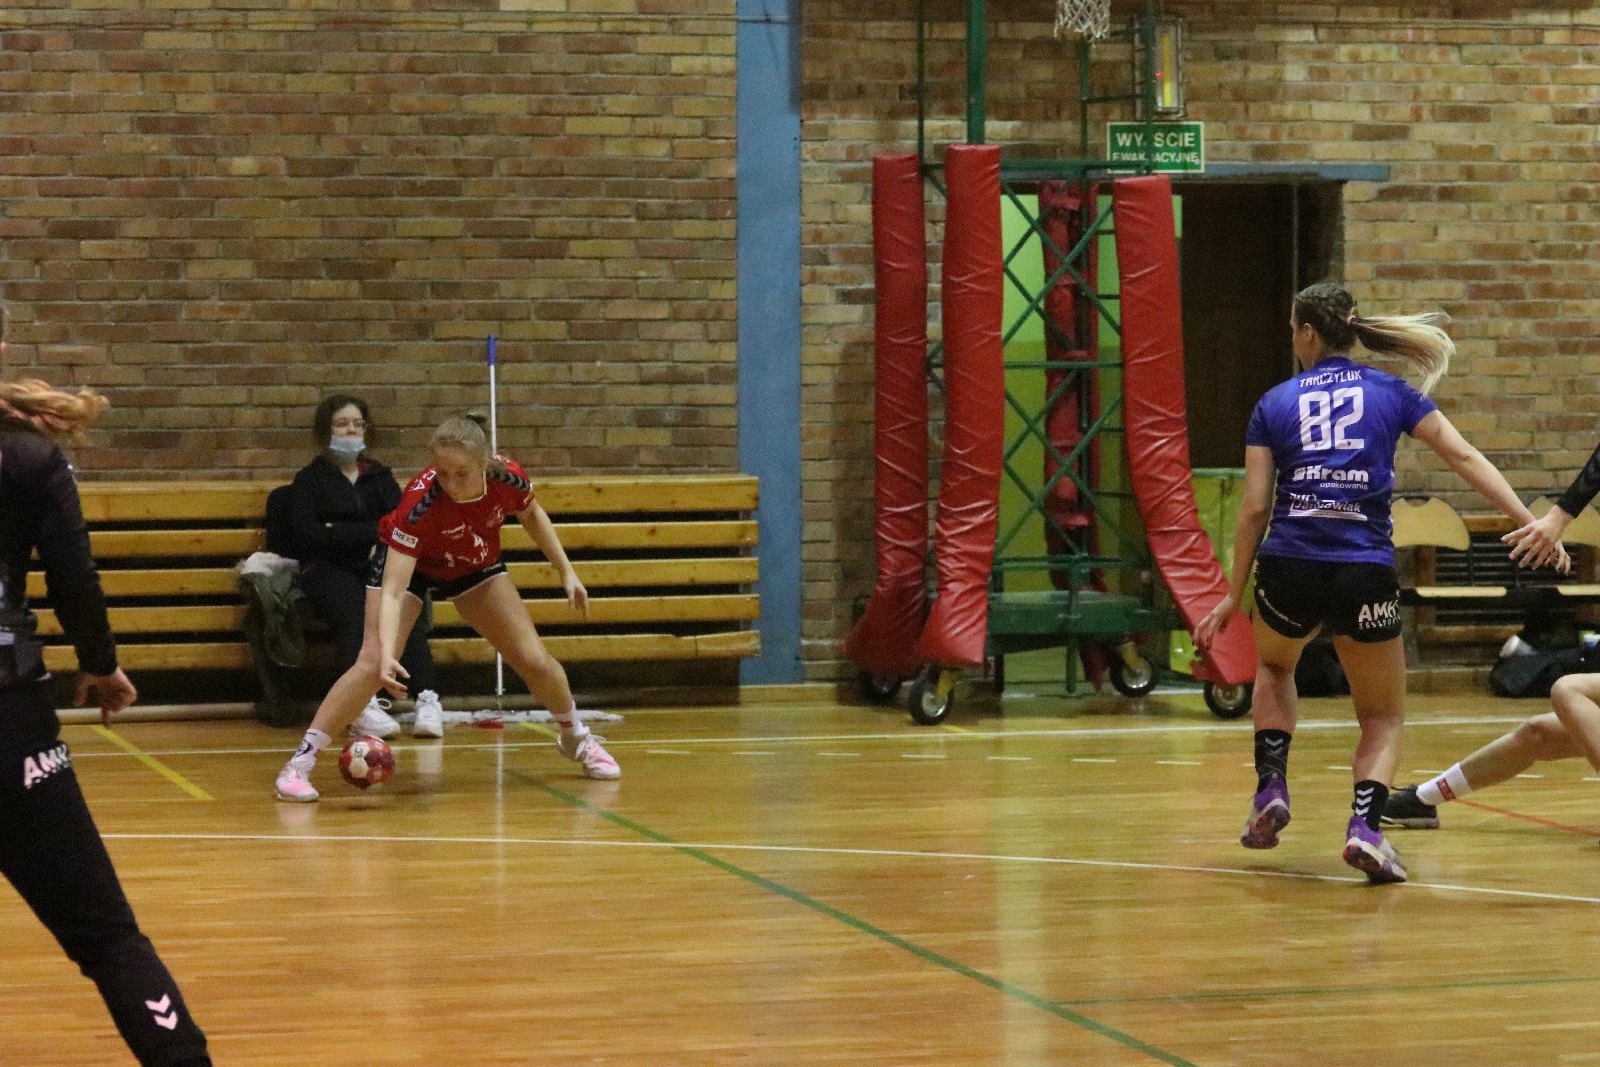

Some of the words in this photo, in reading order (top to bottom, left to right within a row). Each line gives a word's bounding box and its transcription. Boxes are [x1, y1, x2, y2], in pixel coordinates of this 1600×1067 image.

[1112, 152, 1199, 163] EWAKACYJNE
[1299, 387, 1365, 451] 82
[1320, 482, 1368, 490] opakowania
